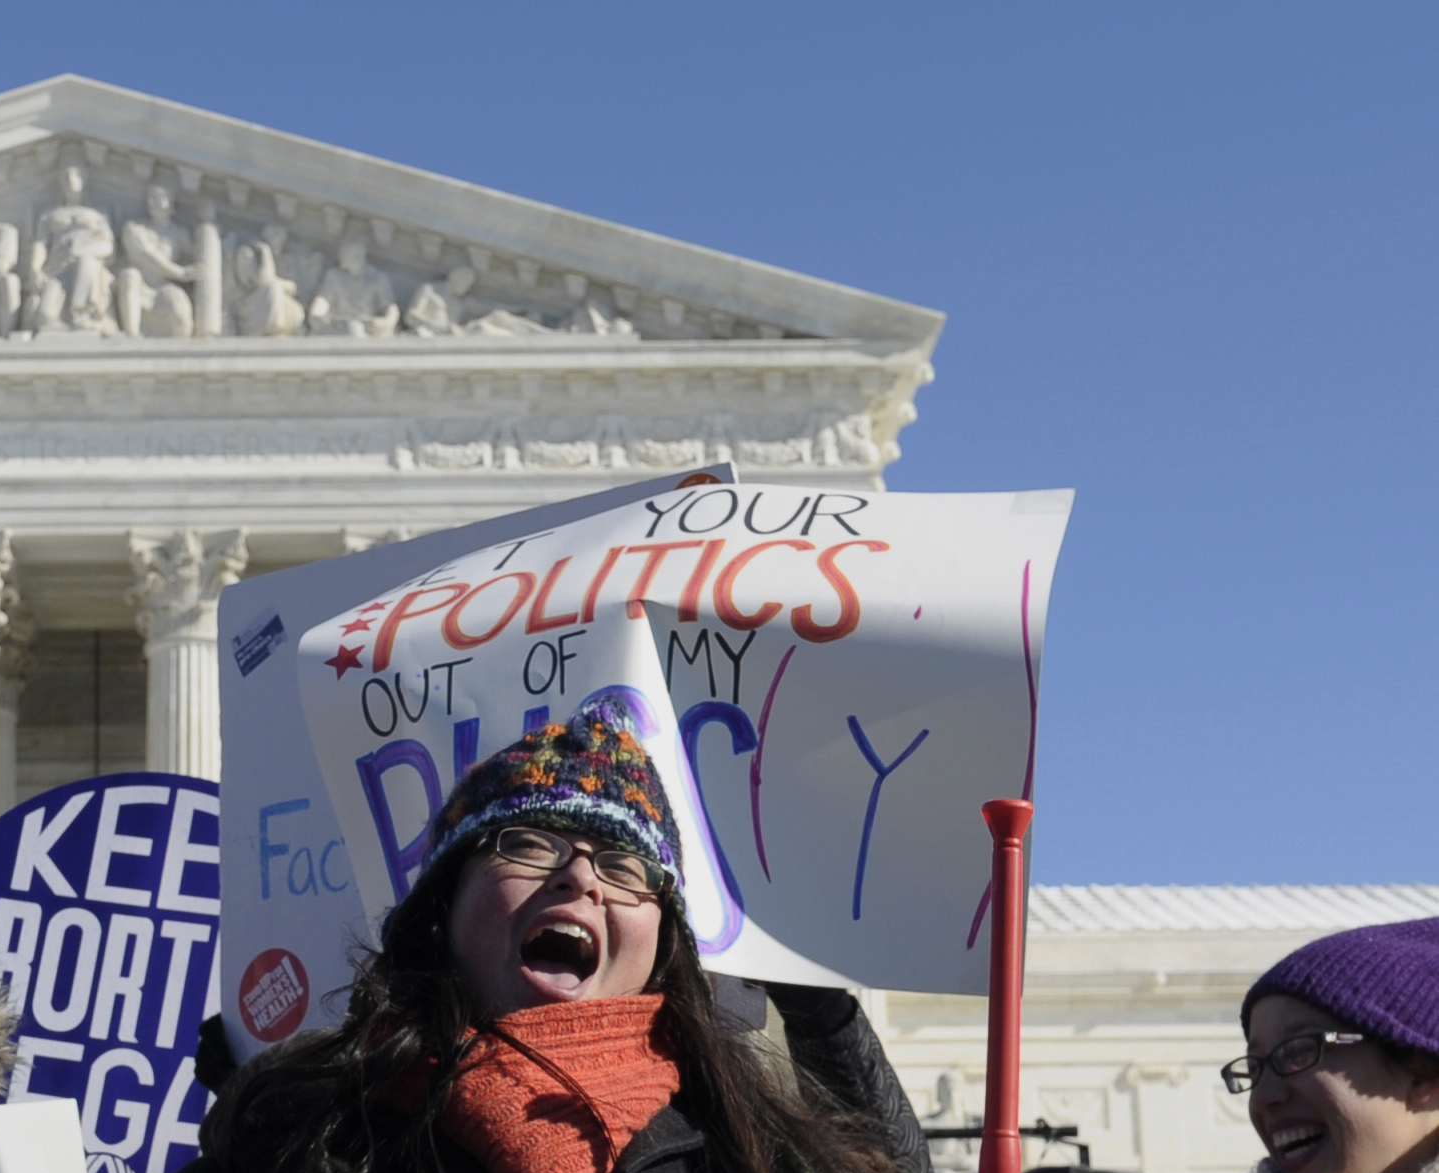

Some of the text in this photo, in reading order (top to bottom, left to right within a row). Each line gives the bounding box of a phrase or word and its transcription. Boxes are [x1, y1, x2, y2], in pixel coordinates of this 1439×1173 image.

[644, 488, 869, 538] YOUR
[372, 538, 889, 674] POLITICS
[361, 628, 758, 738] OUT OF MY
[10, 785, 221, 916] KEE
